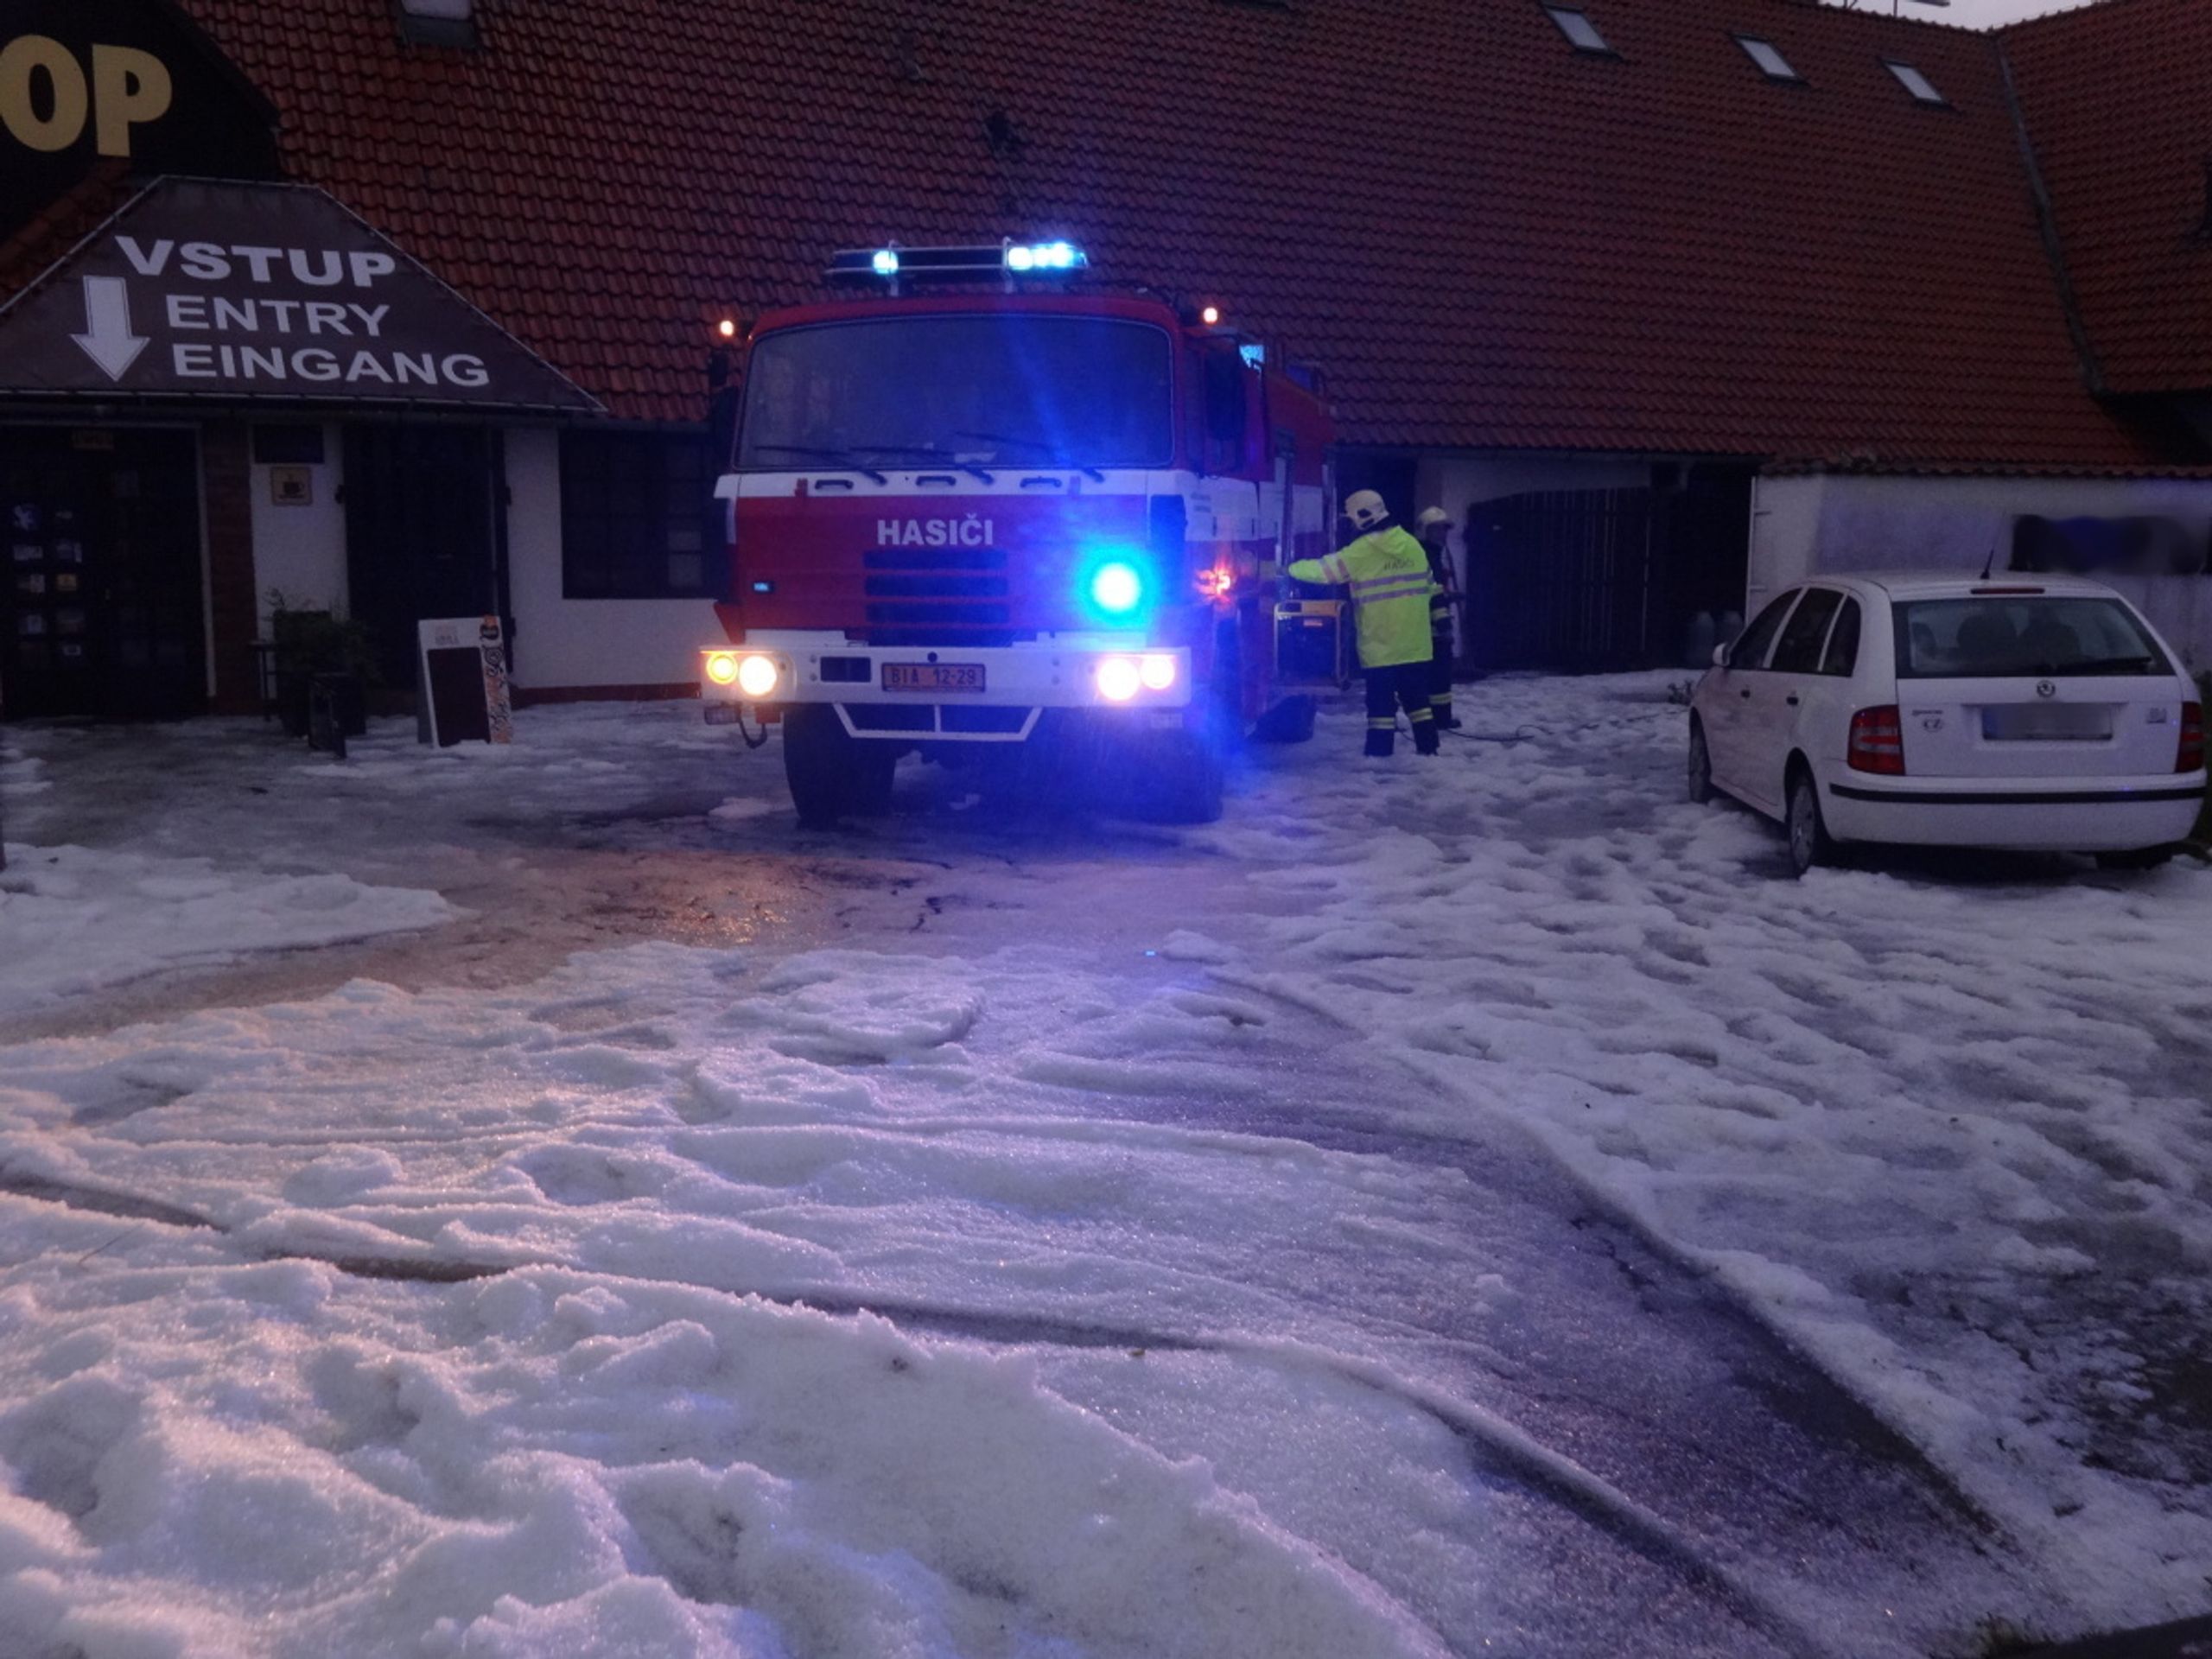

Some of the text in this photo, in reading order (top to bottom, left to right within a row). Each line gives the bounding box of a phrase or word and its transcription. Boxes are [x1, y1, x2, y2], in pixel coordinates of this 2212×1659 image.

[115, 235, 395, 287] VSTUP
[166, 295, 391, 337] ENTRY
[173, 343, 489, 387] EINGANG
[877, 512, 993, 545] HASIČI
